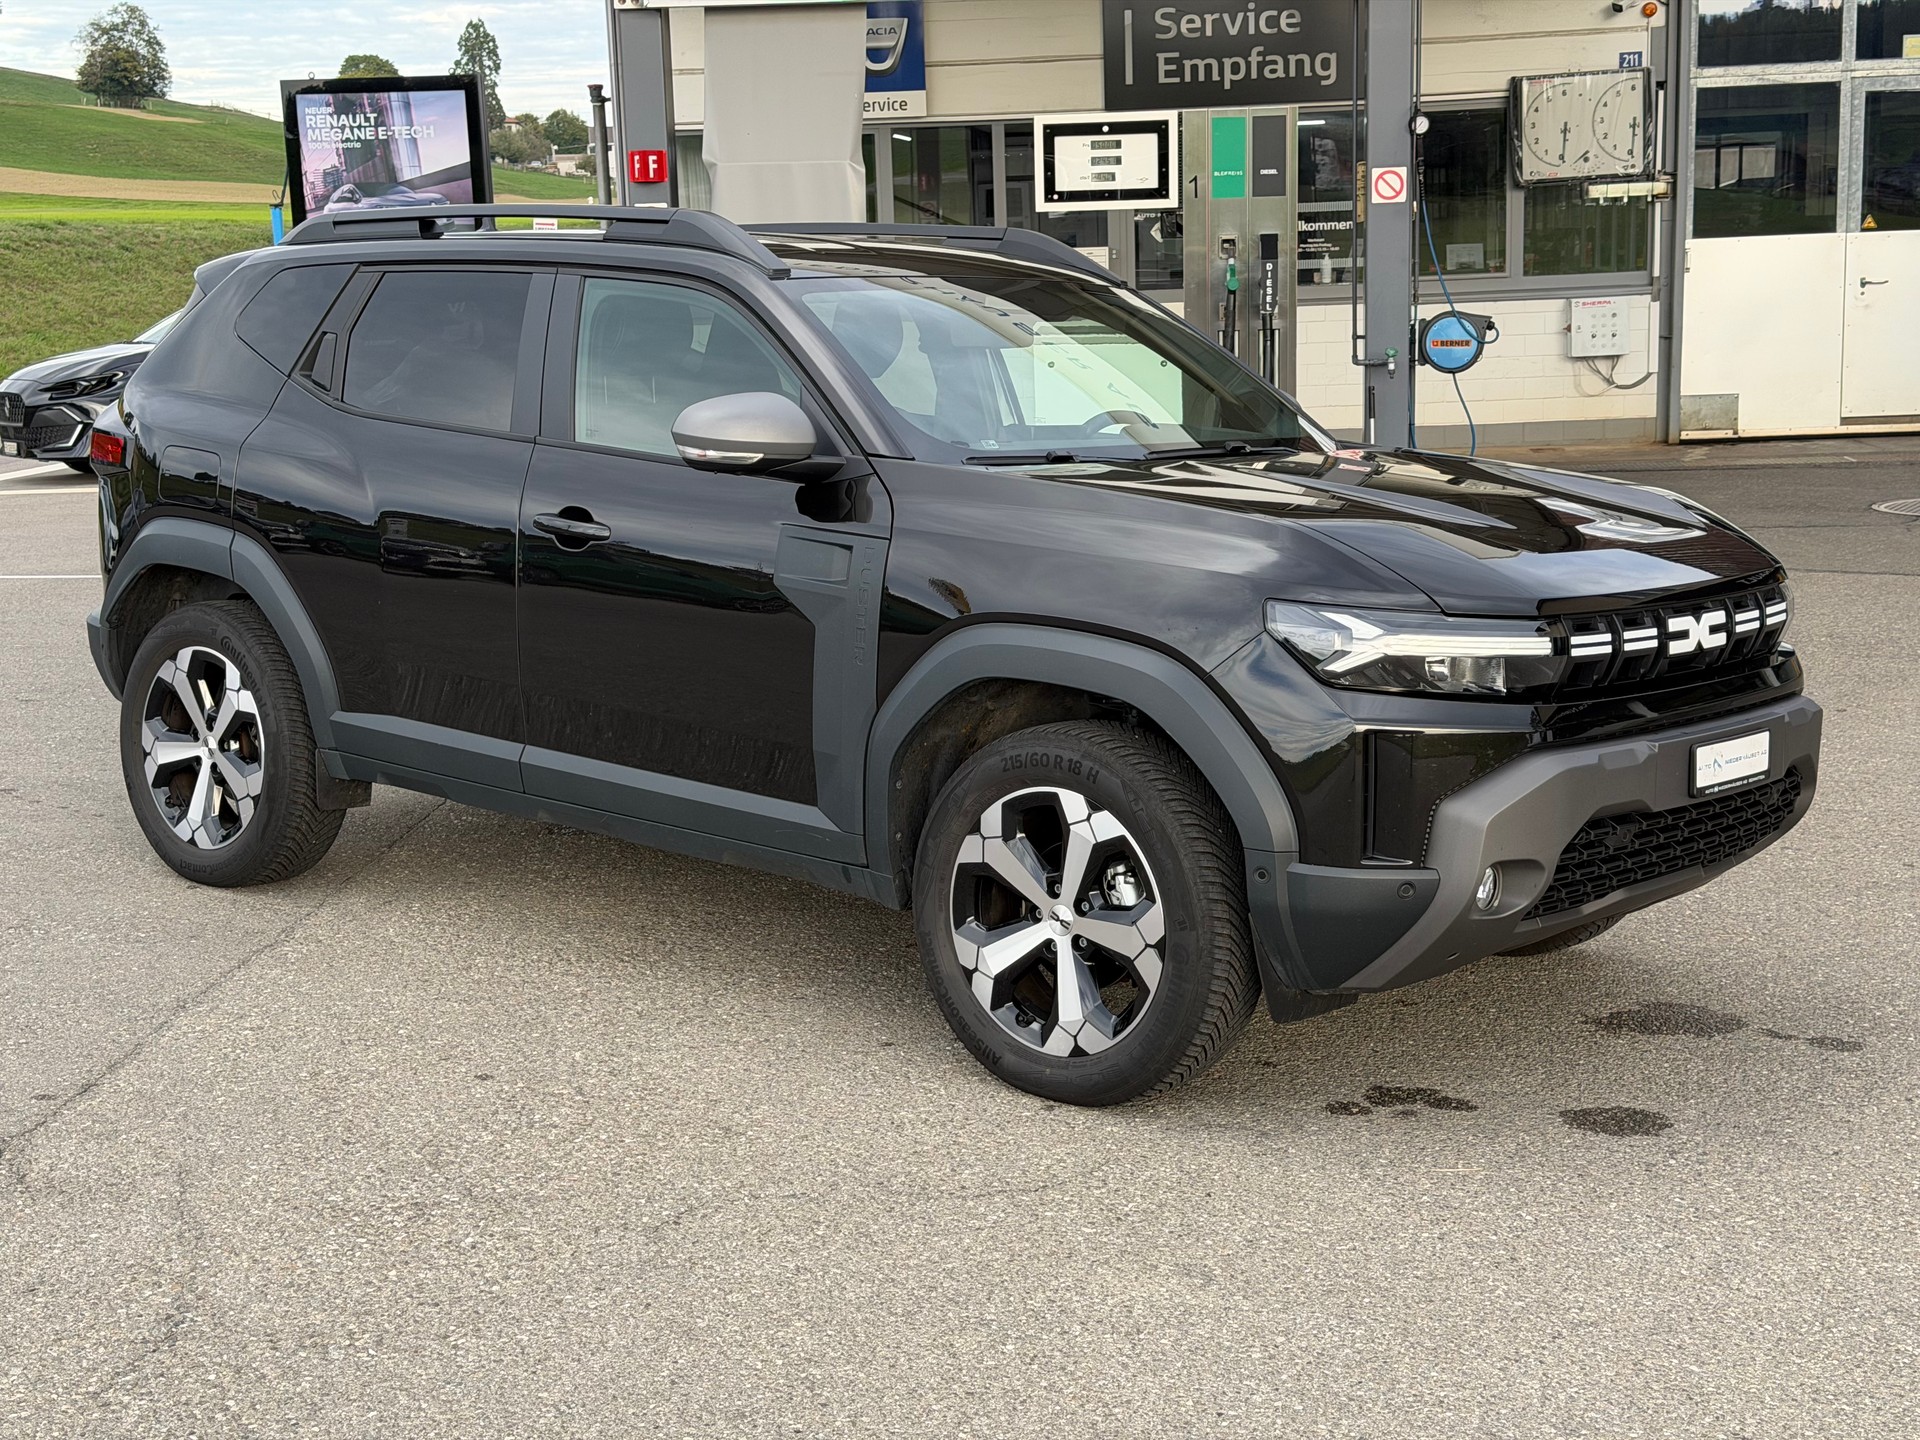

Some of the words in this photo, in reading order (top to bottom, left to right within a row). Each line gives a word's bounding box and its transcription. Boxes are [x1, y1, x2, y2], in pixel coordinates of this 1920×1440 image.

[866, 27, 897, 36] ACIA
[1154, 2, 1301, 39] Service
[1155, 46, 1337, 90] Empfang
[1622, 54, 1639, 67] 211
[863, 97, 908, 112] ervice
[305, 114, 377, 127] RENAULT
[307, 127, 375, 141] MEGANE
[378, 125, 434, 140] E-TECH
[332, 141, 361, 149] electric
[634, 155, 640, 178] F
[648, 155, 658, 178] F
[1189, 175, 1198, 198] 1
[221, 635, 267, 708] Continental
[1001, 752, 1050, 772] 215/60
[1054, 754, 1064, 770] R
[1067, 758, 1083, 776] 18
[1086, 766, 1100, 784] H
